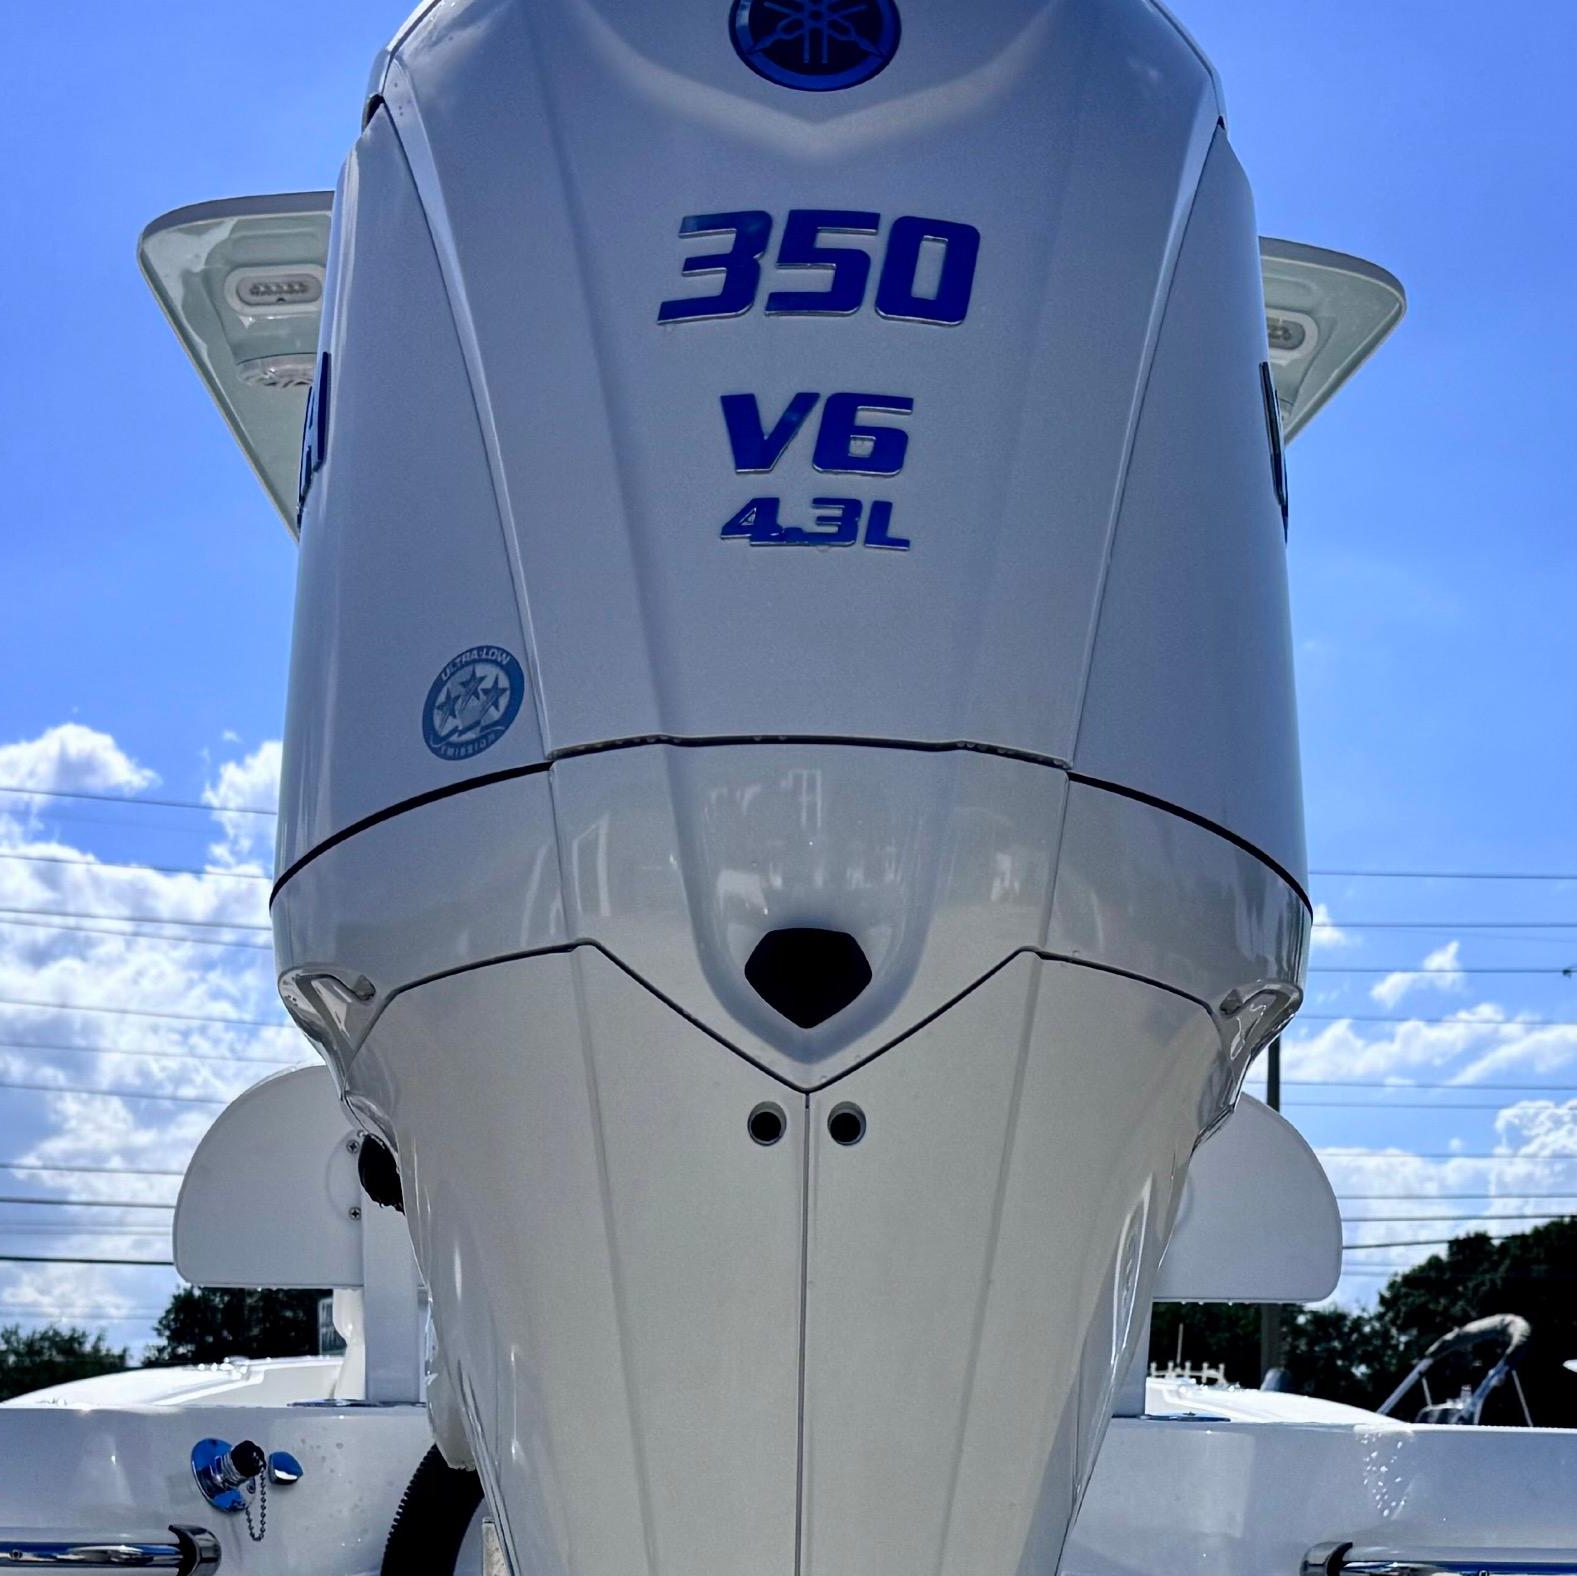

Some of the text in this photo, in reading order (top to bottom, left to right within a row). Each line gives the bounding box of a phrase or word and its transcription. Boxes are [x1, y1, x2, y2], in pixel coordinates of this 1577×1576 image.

[657, 209, 981, 327] 350
[720, 392, 914, 477] V6
[720, 496, 911, 551] 4.3L
